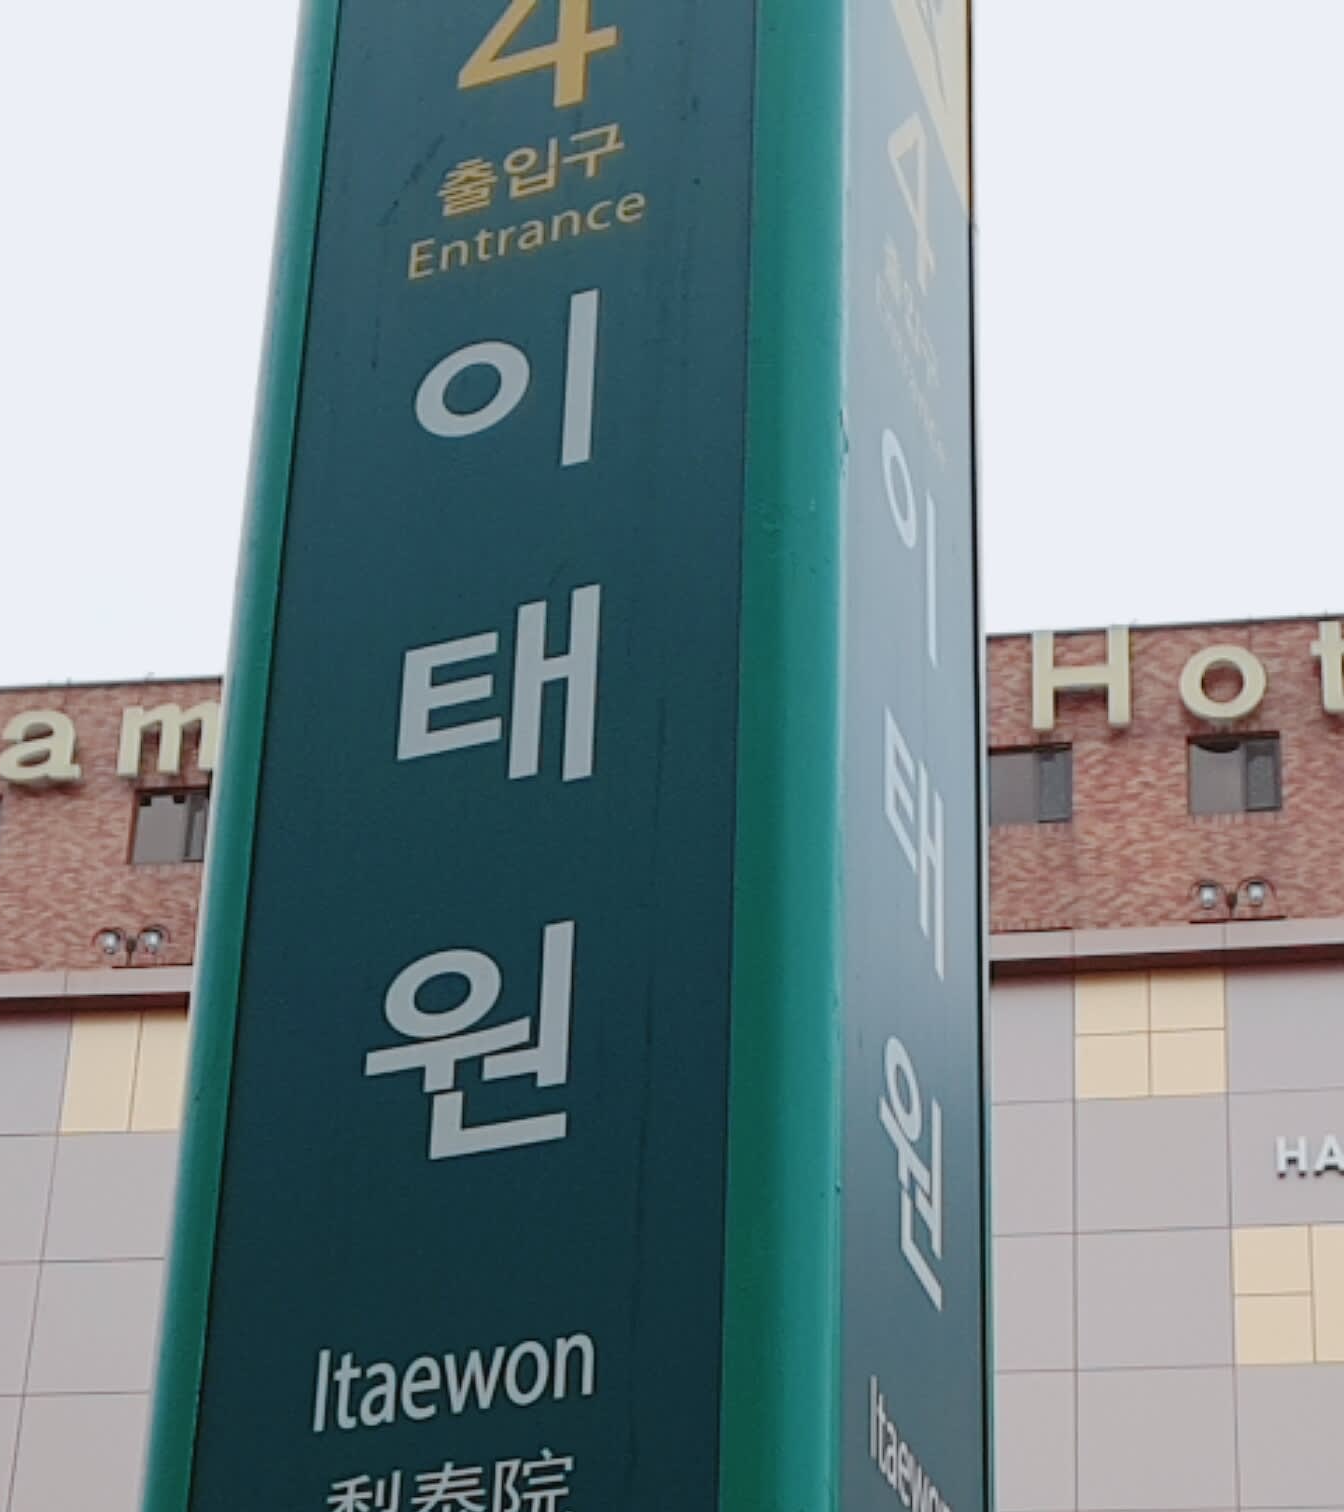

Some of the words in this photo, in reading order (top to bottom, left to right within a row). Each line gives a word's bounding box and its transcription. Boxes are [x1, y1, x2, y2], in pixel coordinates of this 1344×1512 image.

[437, 122, 624, 218] 출입구
[407, 191, 646, 281] Entrance
[312, 1331, 595, 1432] Itaewon
